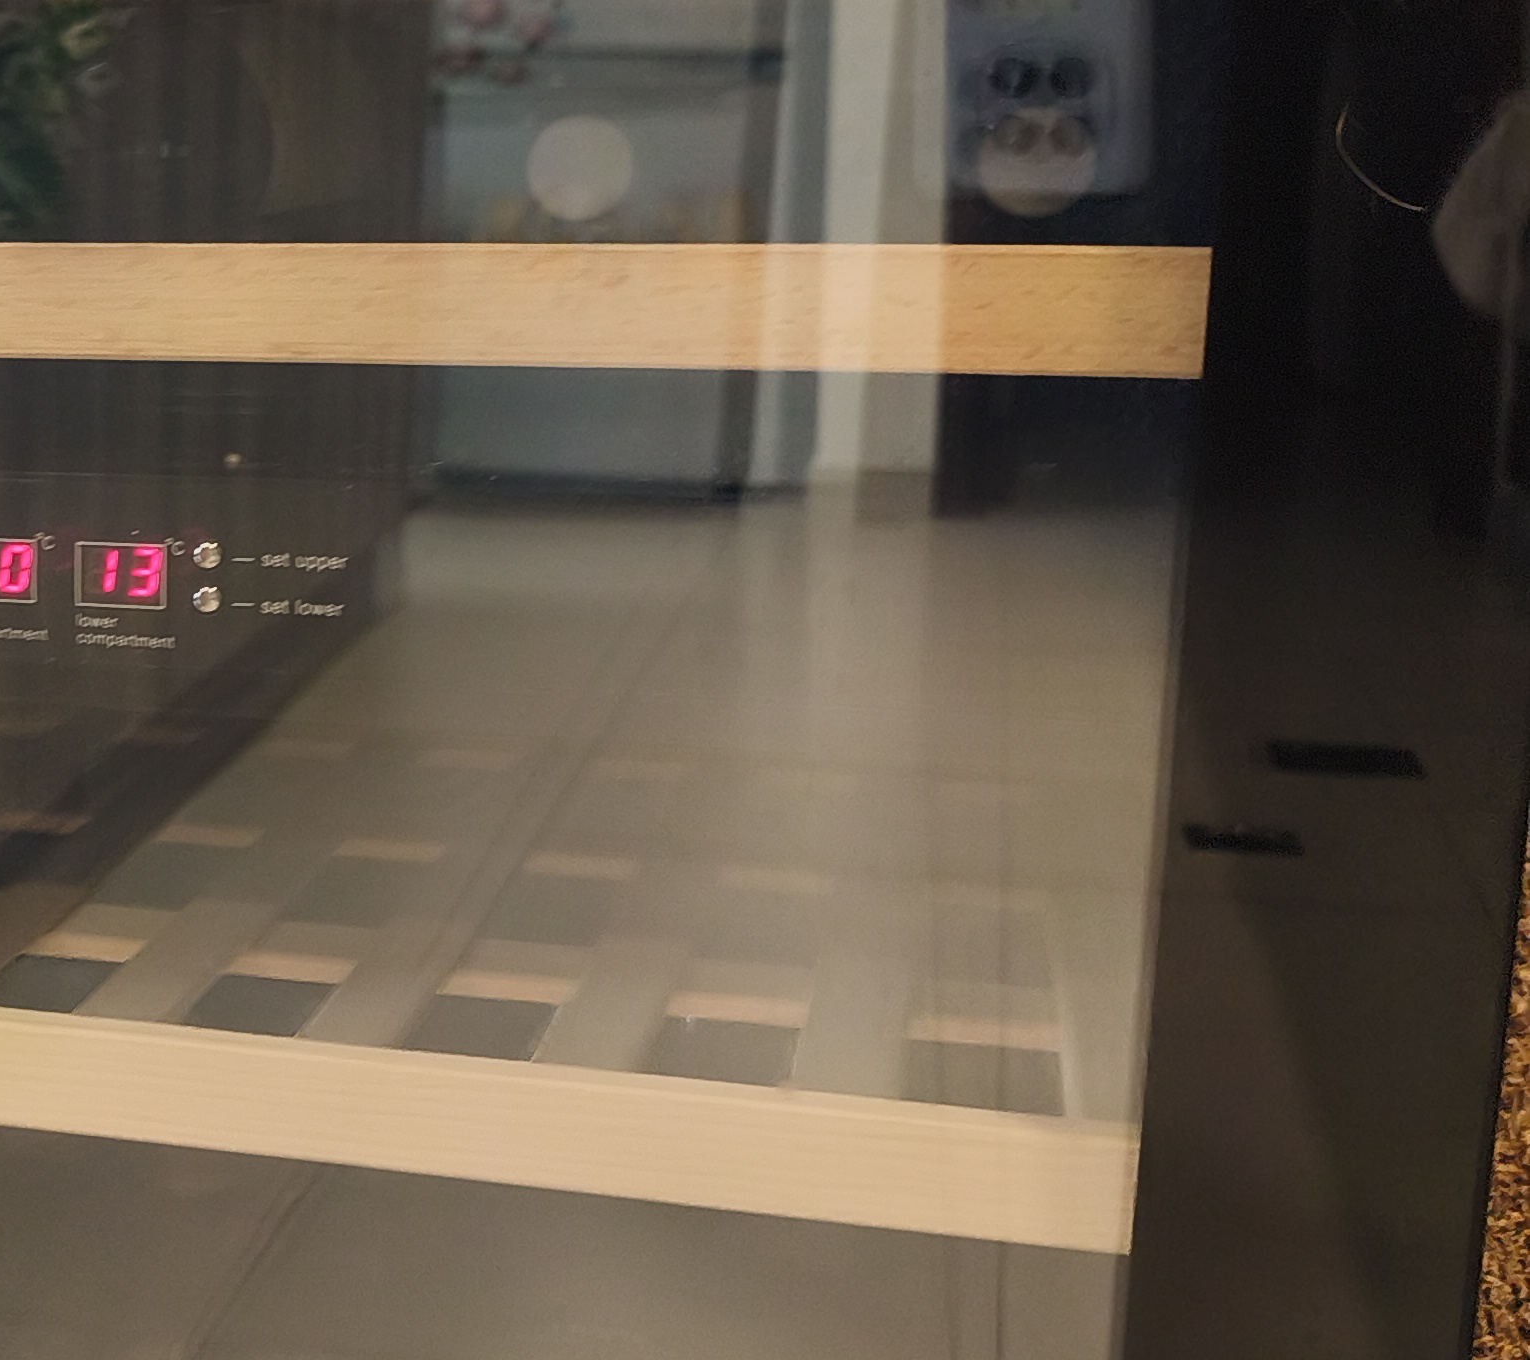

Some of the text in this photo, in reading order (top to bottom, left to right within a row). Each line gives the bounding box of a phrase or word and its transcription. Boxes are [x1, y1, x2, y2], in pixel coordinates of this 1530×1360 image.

[102, 546, 164, 597] 13
[260, 553, 350, 572] set upper
[259, 599, 345, 616] set lower
[74, 613, 119, 628] lower
